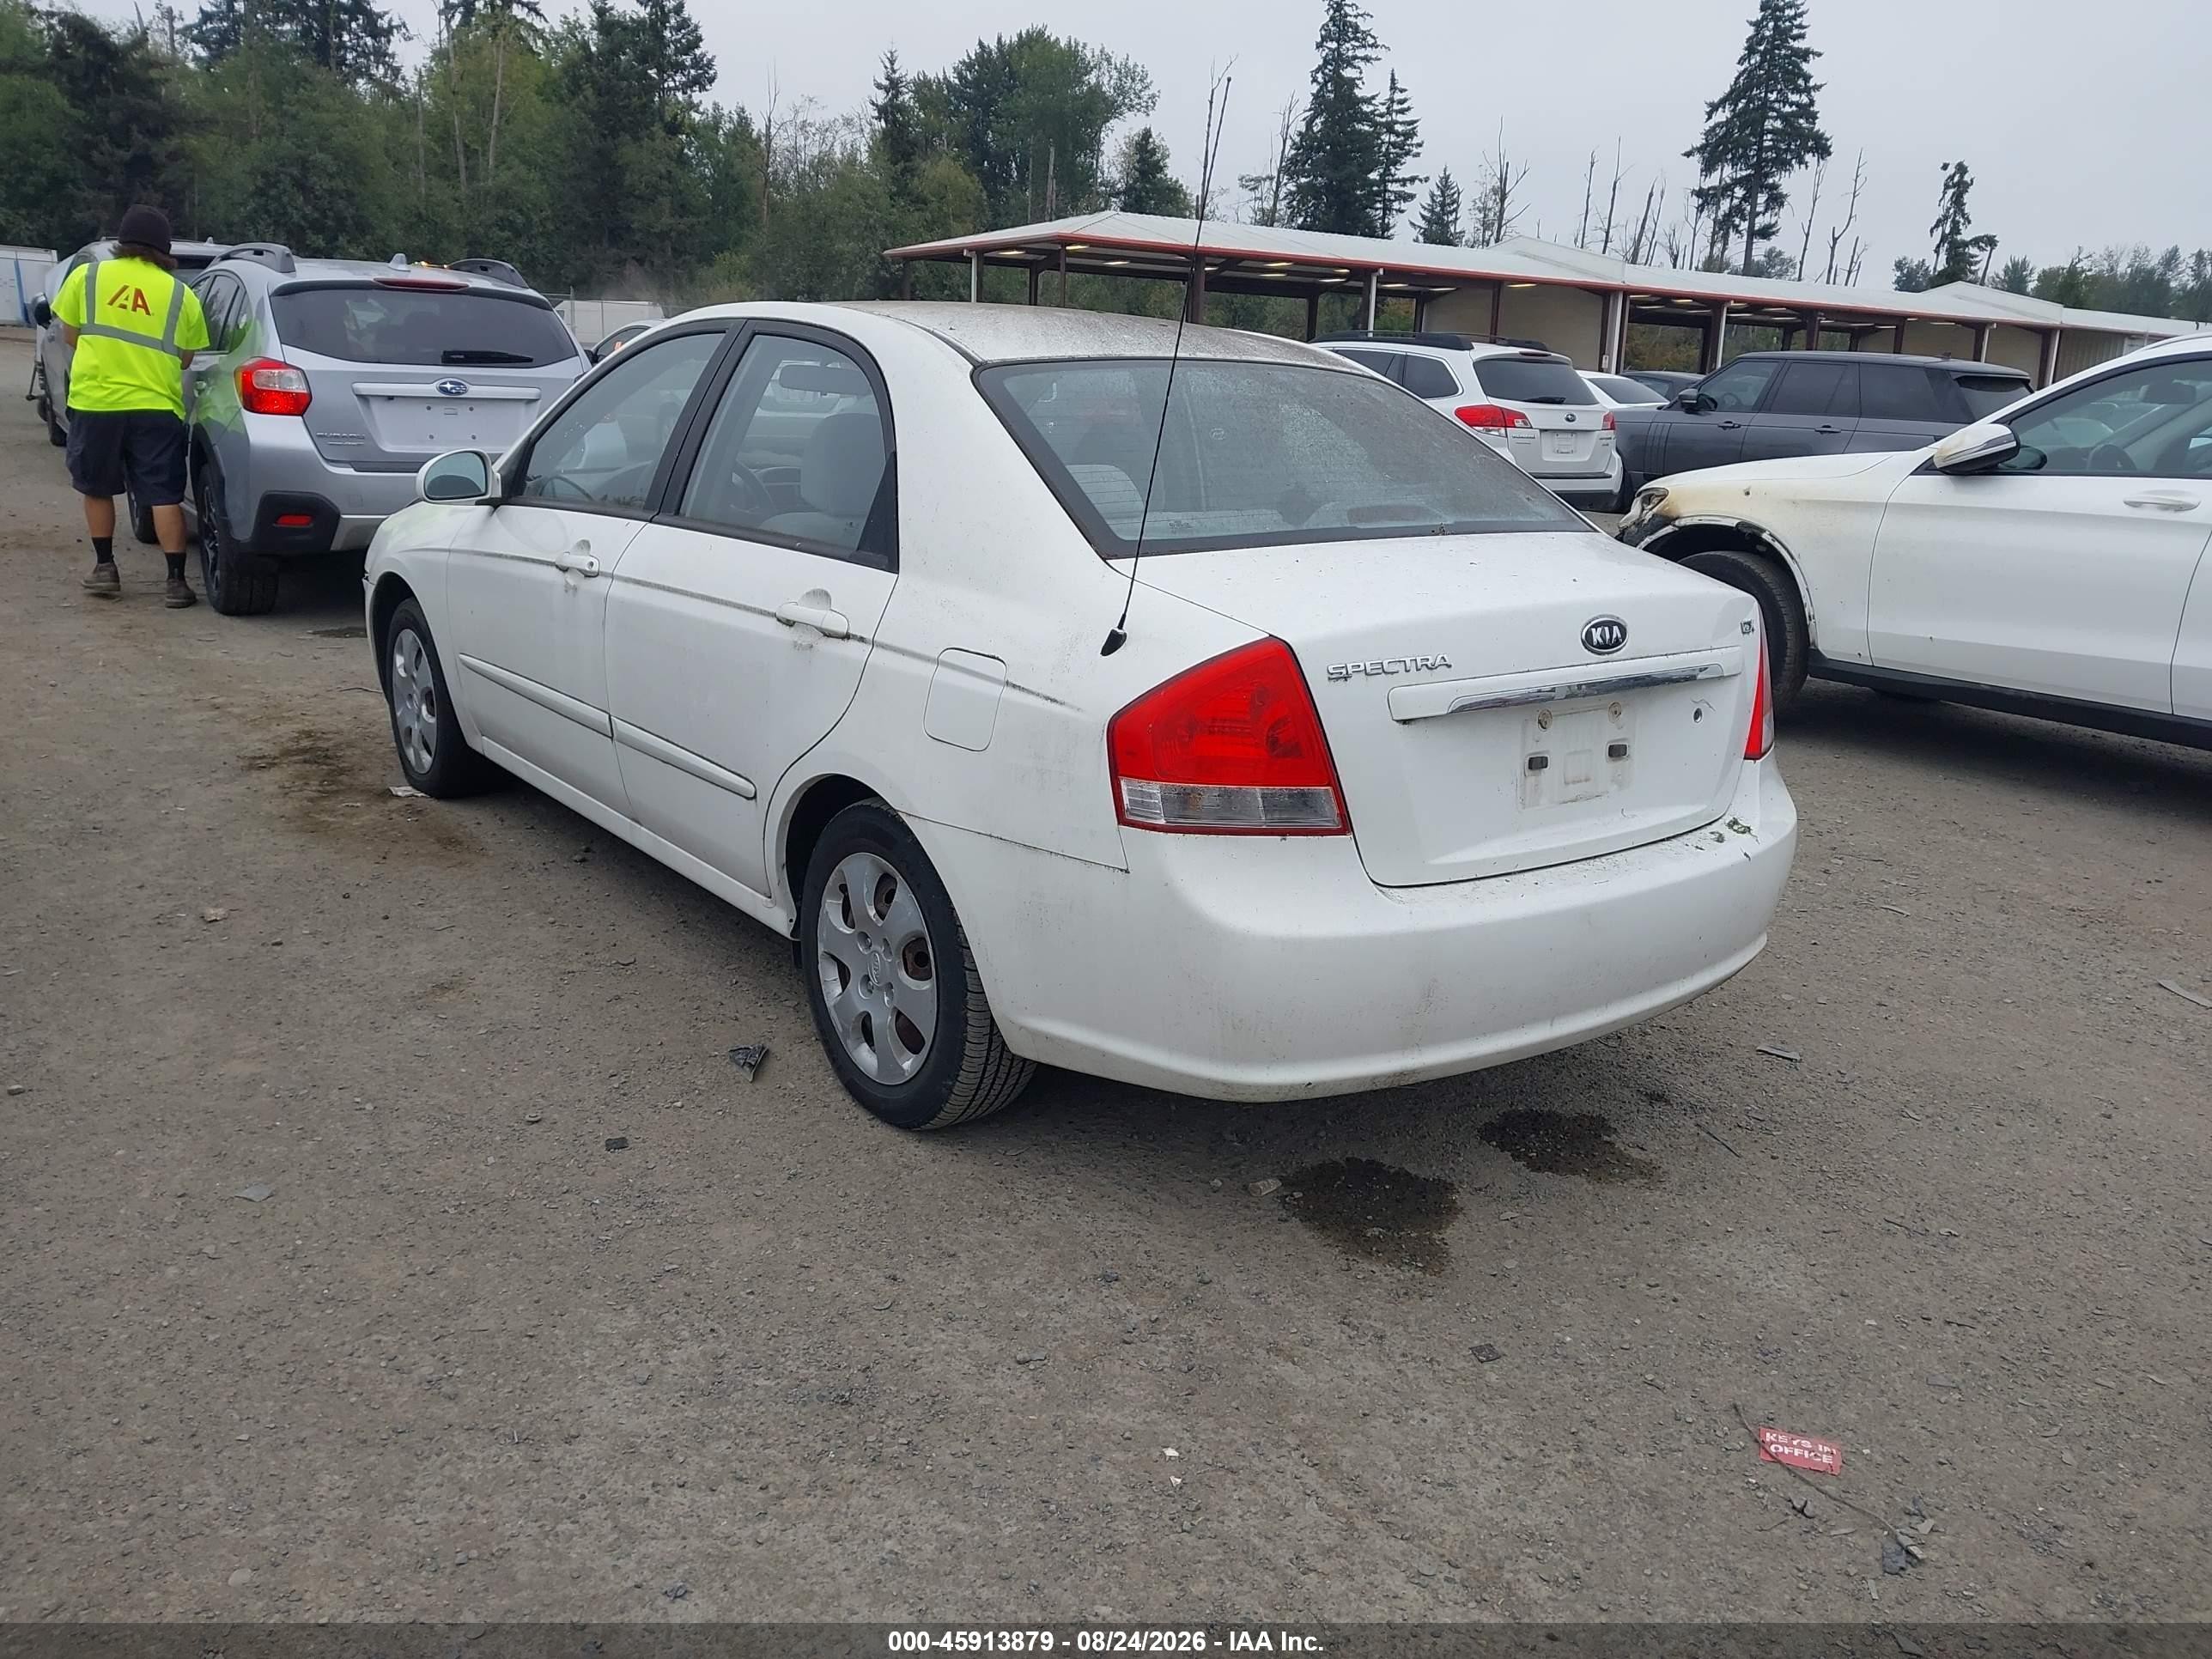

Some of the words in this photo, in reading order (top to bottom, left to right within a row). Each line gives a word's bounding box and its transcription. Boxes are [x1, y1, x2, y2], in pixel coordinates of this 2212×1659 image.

[1591, 625, 1623, 647] KIA
[1327, 653, 1452, 679] SPECTRA
[1765, 1431, 1812, 1448] KEYS
[1817, 1443, 1837, 1455] IN
[1770, 1443, 1833, 1464] OFFICE
